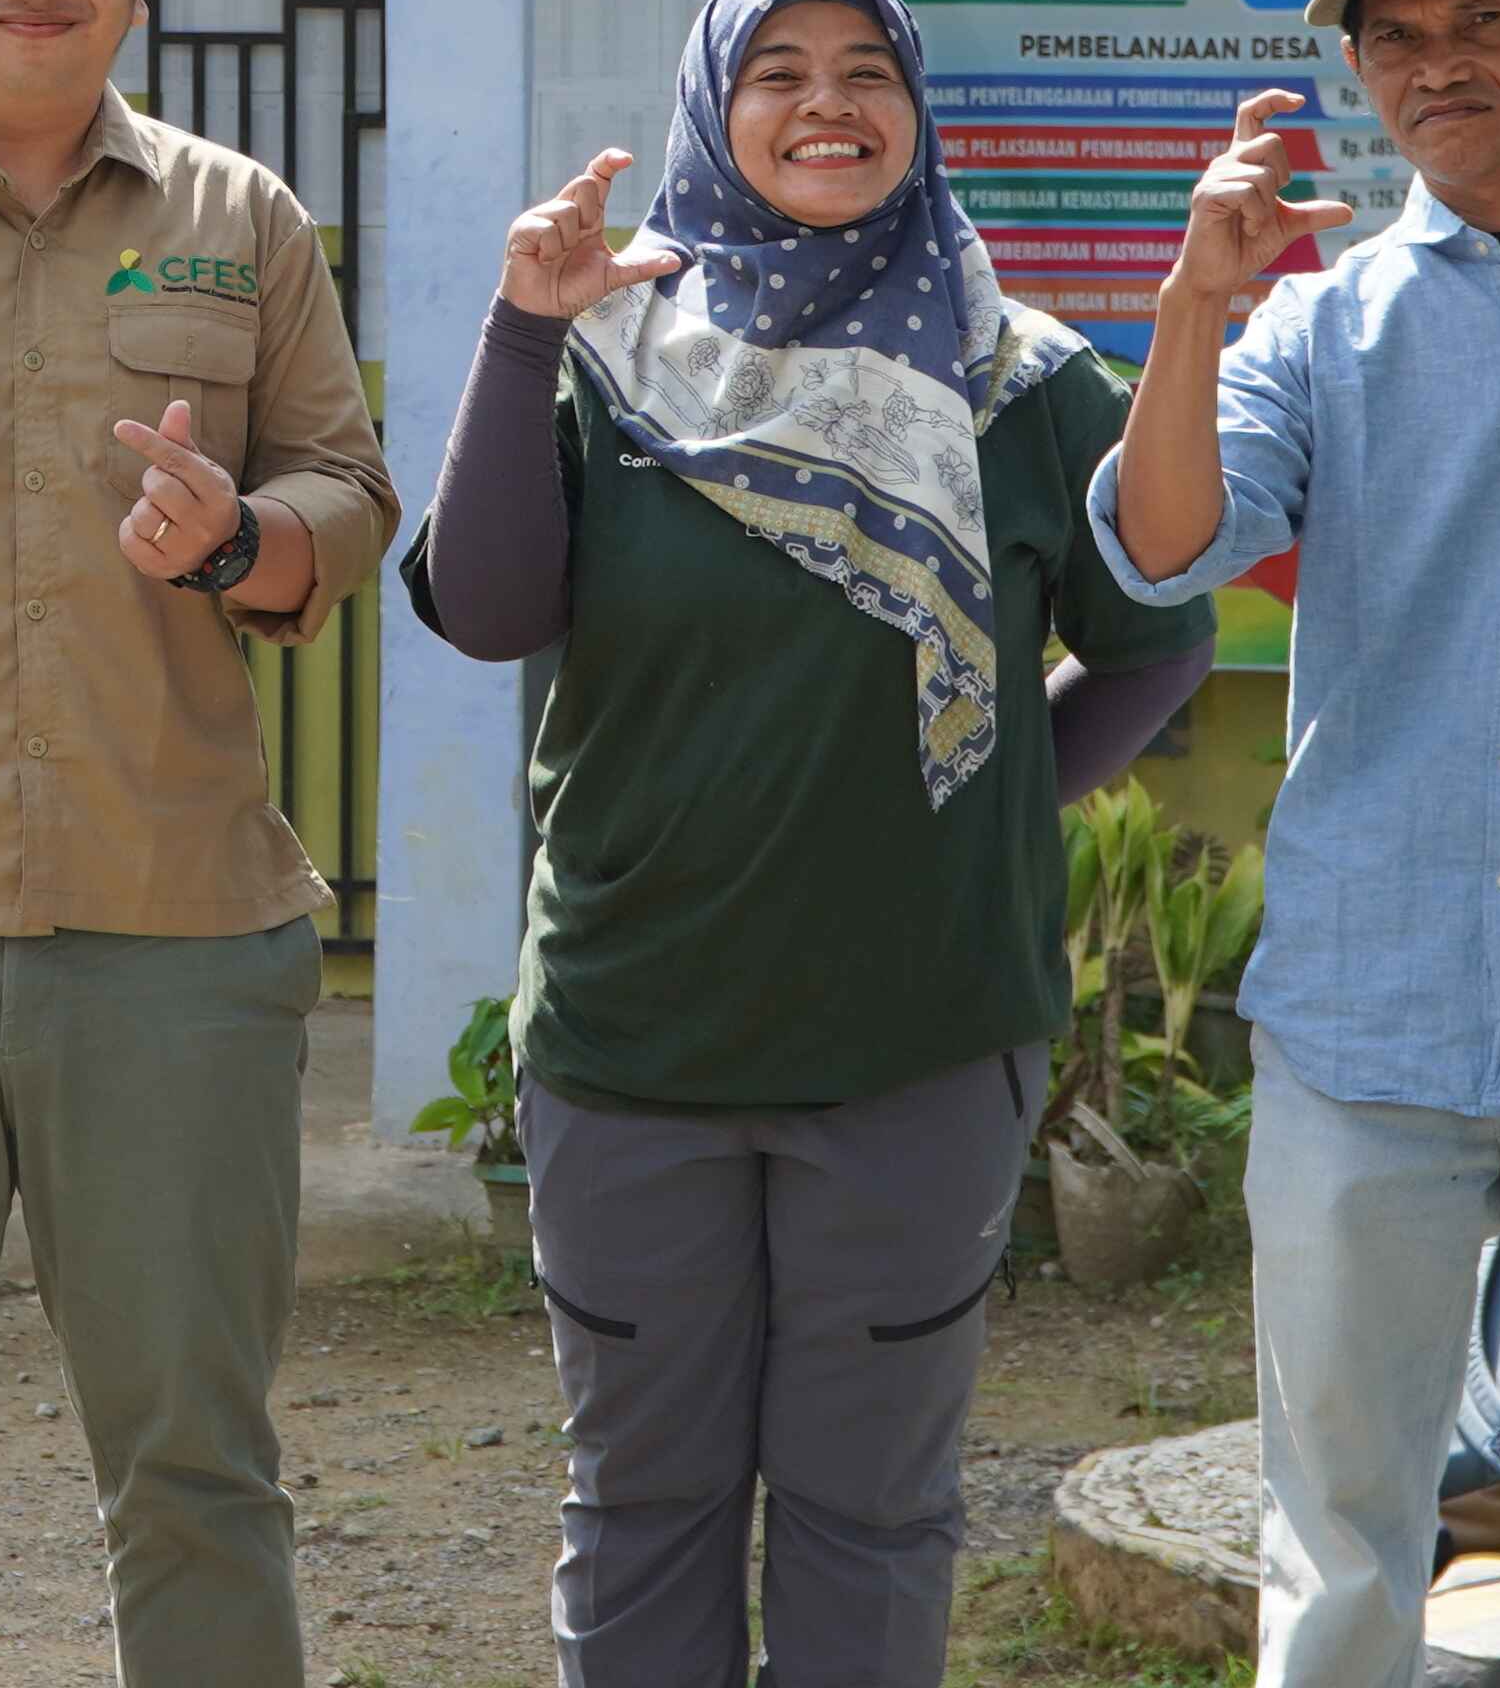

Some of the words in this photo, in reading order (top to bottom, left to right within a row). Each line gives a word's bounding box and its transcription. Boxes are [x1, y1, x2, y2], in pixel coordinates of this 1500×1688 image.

[1020, 34, 1239, 60] PEMBELANJAAN
[1252, 36, 1322, 60] DESA
[157, 256, 258, 294] CFES
[619, 453, 662, 468] Com
